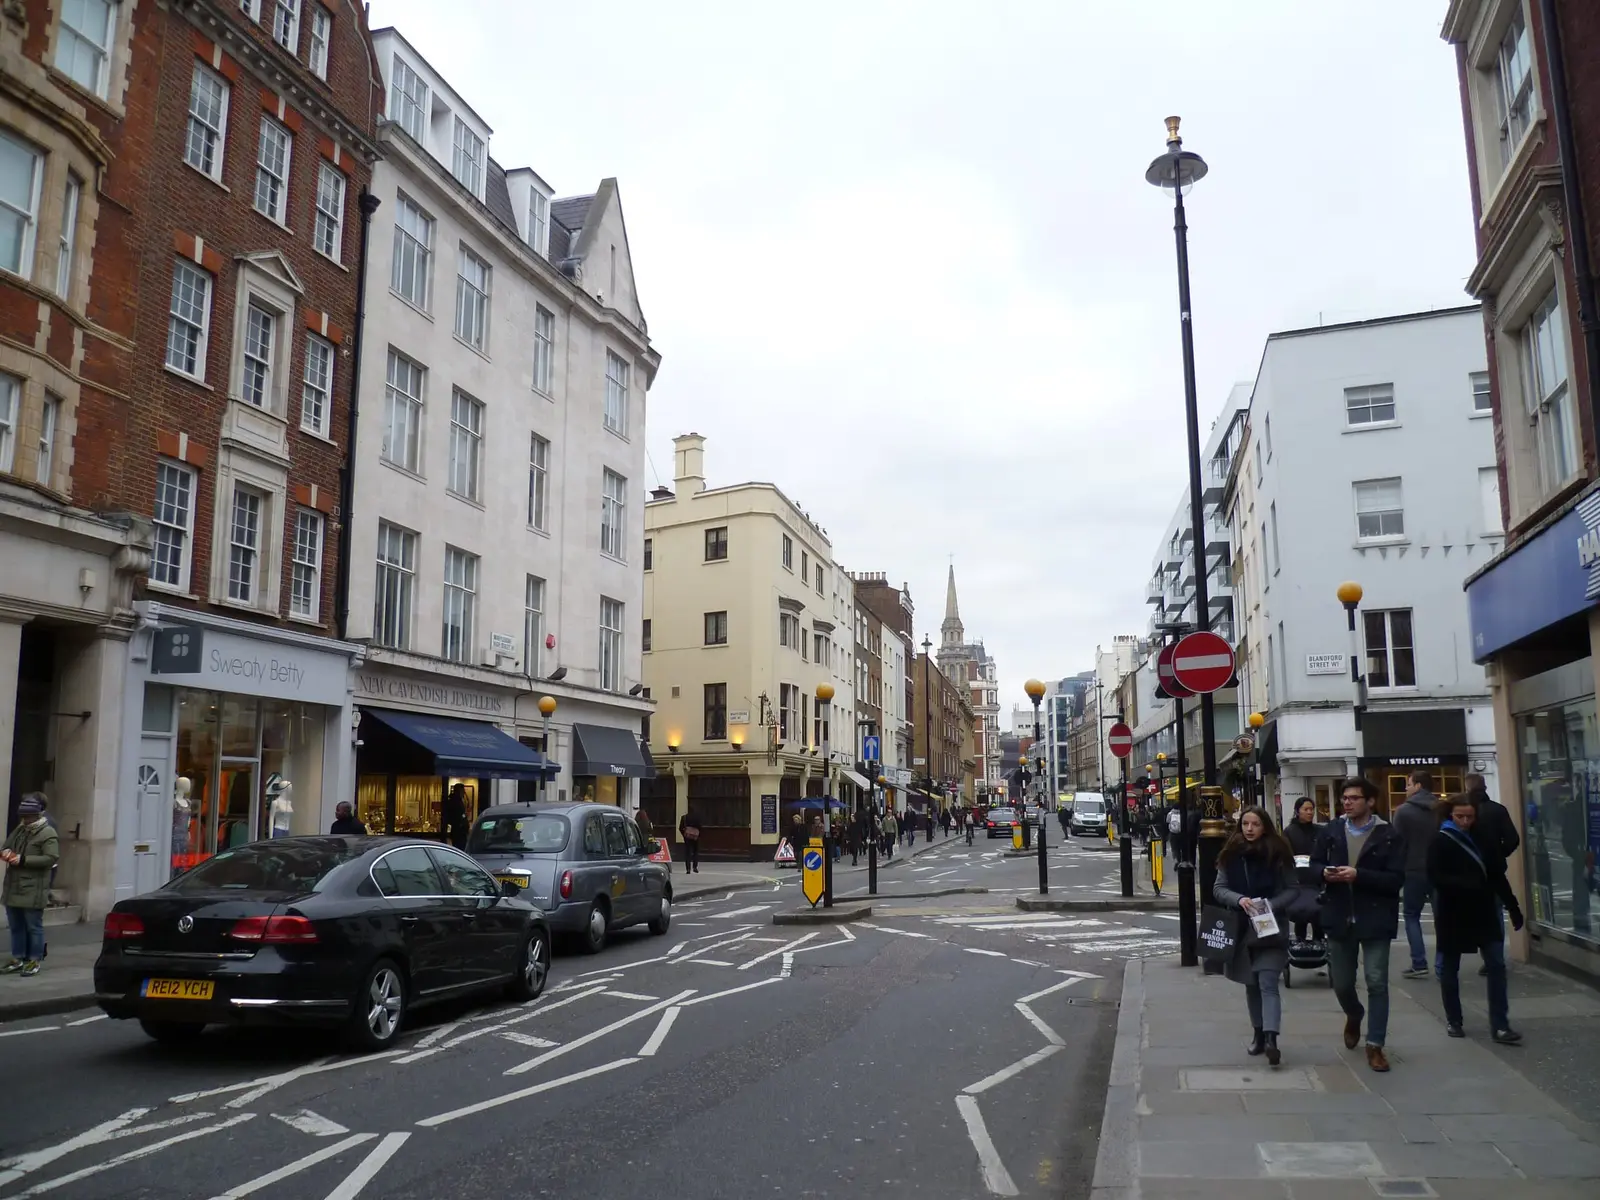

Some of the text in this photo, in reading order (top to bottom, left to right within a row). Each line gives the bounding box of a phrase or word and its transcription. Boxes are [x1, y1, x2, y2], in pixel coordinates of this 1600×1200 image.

[210, 649, 305, 690] Sweaty Betty
[1309, 661, 1329, 669] STREET
[360, 675, 502, 712] NEW CAVENDISH JEWELLERS
[1389, 757, 1440, 765] WHISTLES
[610, 764, 626, 776] Theory
[1201, 932, 1233, 945] MONOCLE
[1211, 928, 1226, 938] THE
[1206, 940, 1226, 950] SHOP
[151, 980, 209, 996] RE12 YCH
